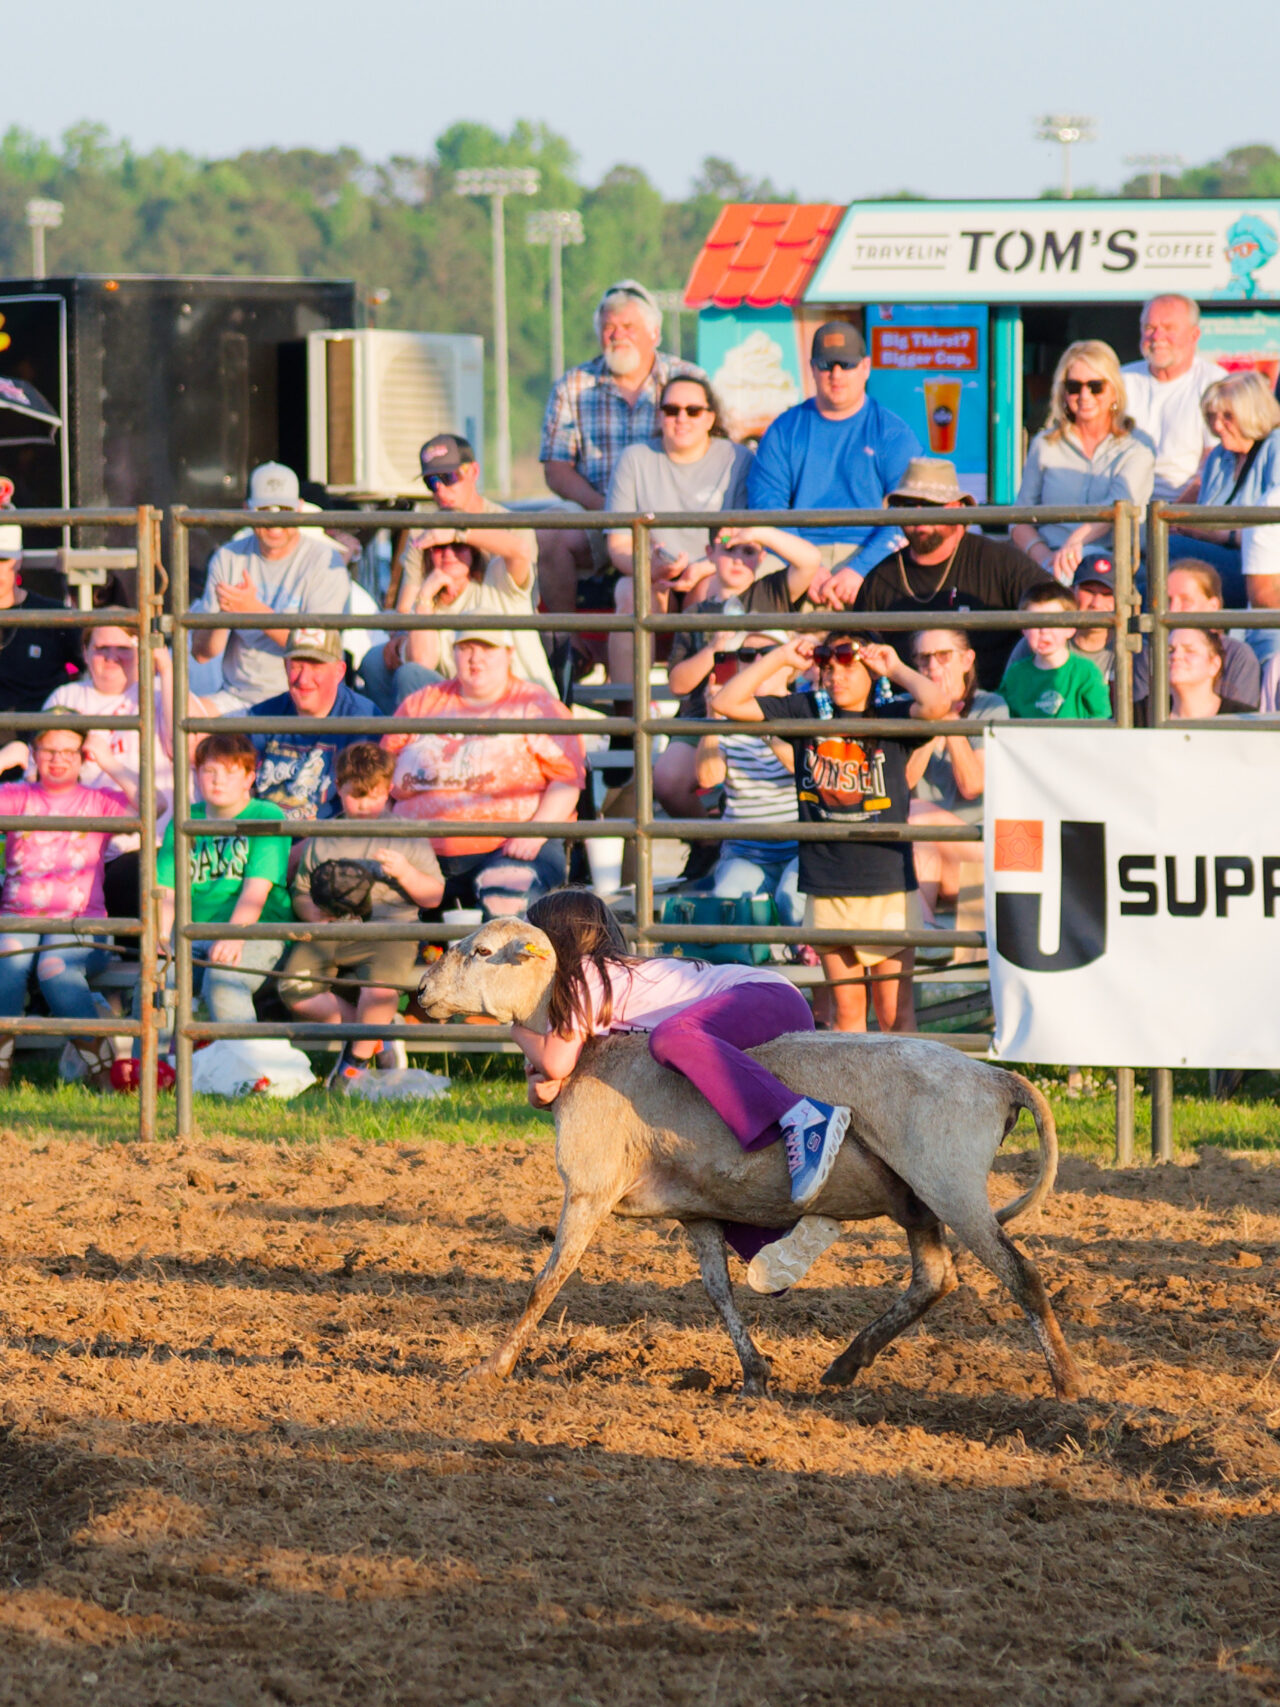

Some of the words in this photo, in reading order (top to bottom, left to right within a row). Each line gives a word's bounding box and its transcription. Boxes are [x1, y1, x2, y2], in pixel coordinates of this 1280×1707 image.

[960, 229, 1138, 273] TOM'S
[1146, 244, 1215, 259] COFFEE
[882, 333, 908, 350] Big
[911, 332, 970, 348] Thirst?
[882, 350, 931, 367] Bigger
